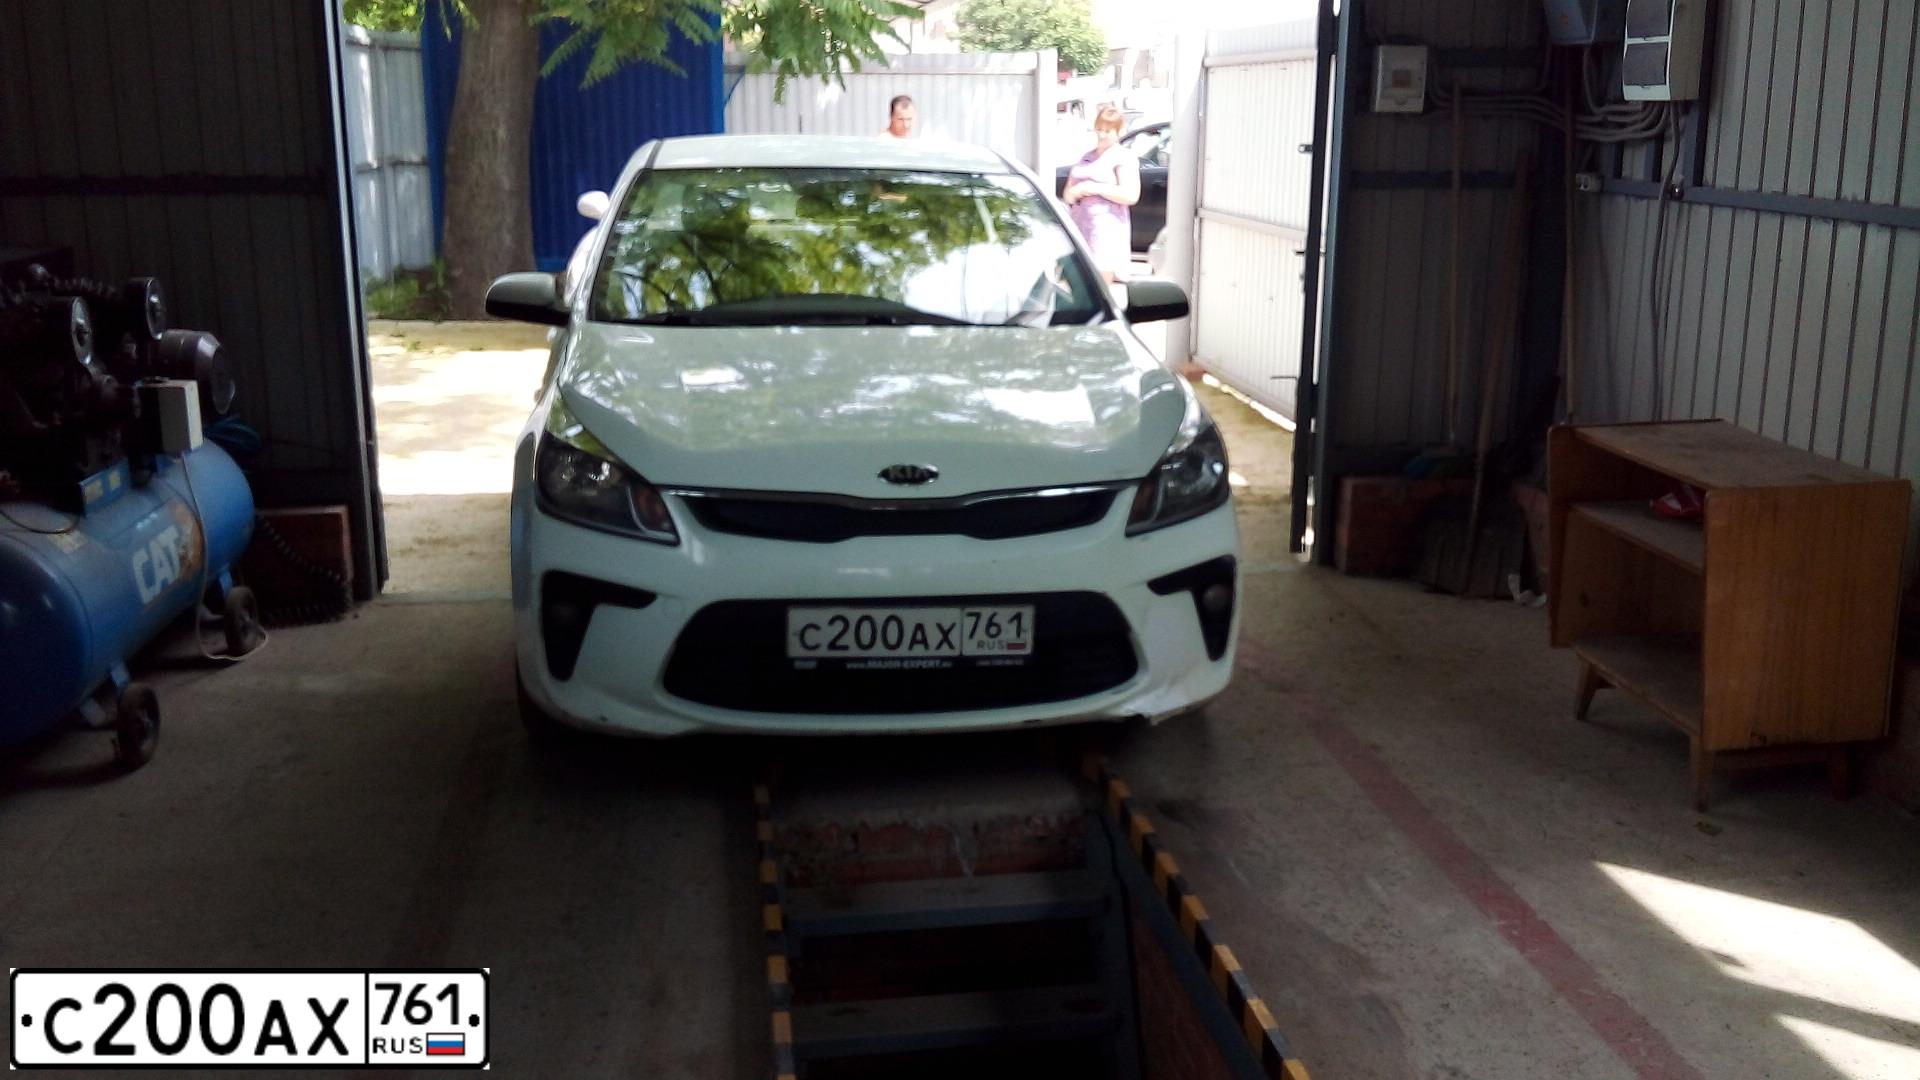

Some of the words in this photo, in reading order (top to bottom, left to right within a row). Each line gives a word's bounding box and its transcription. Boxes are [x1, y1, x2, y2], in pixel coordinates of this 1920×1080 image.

[889, 468, 929, 480] KIA
[800, 614, 956, 650] C200AX
[966, 611, 1023, 639] 761
[977, 640, 1005, 650] RUS
